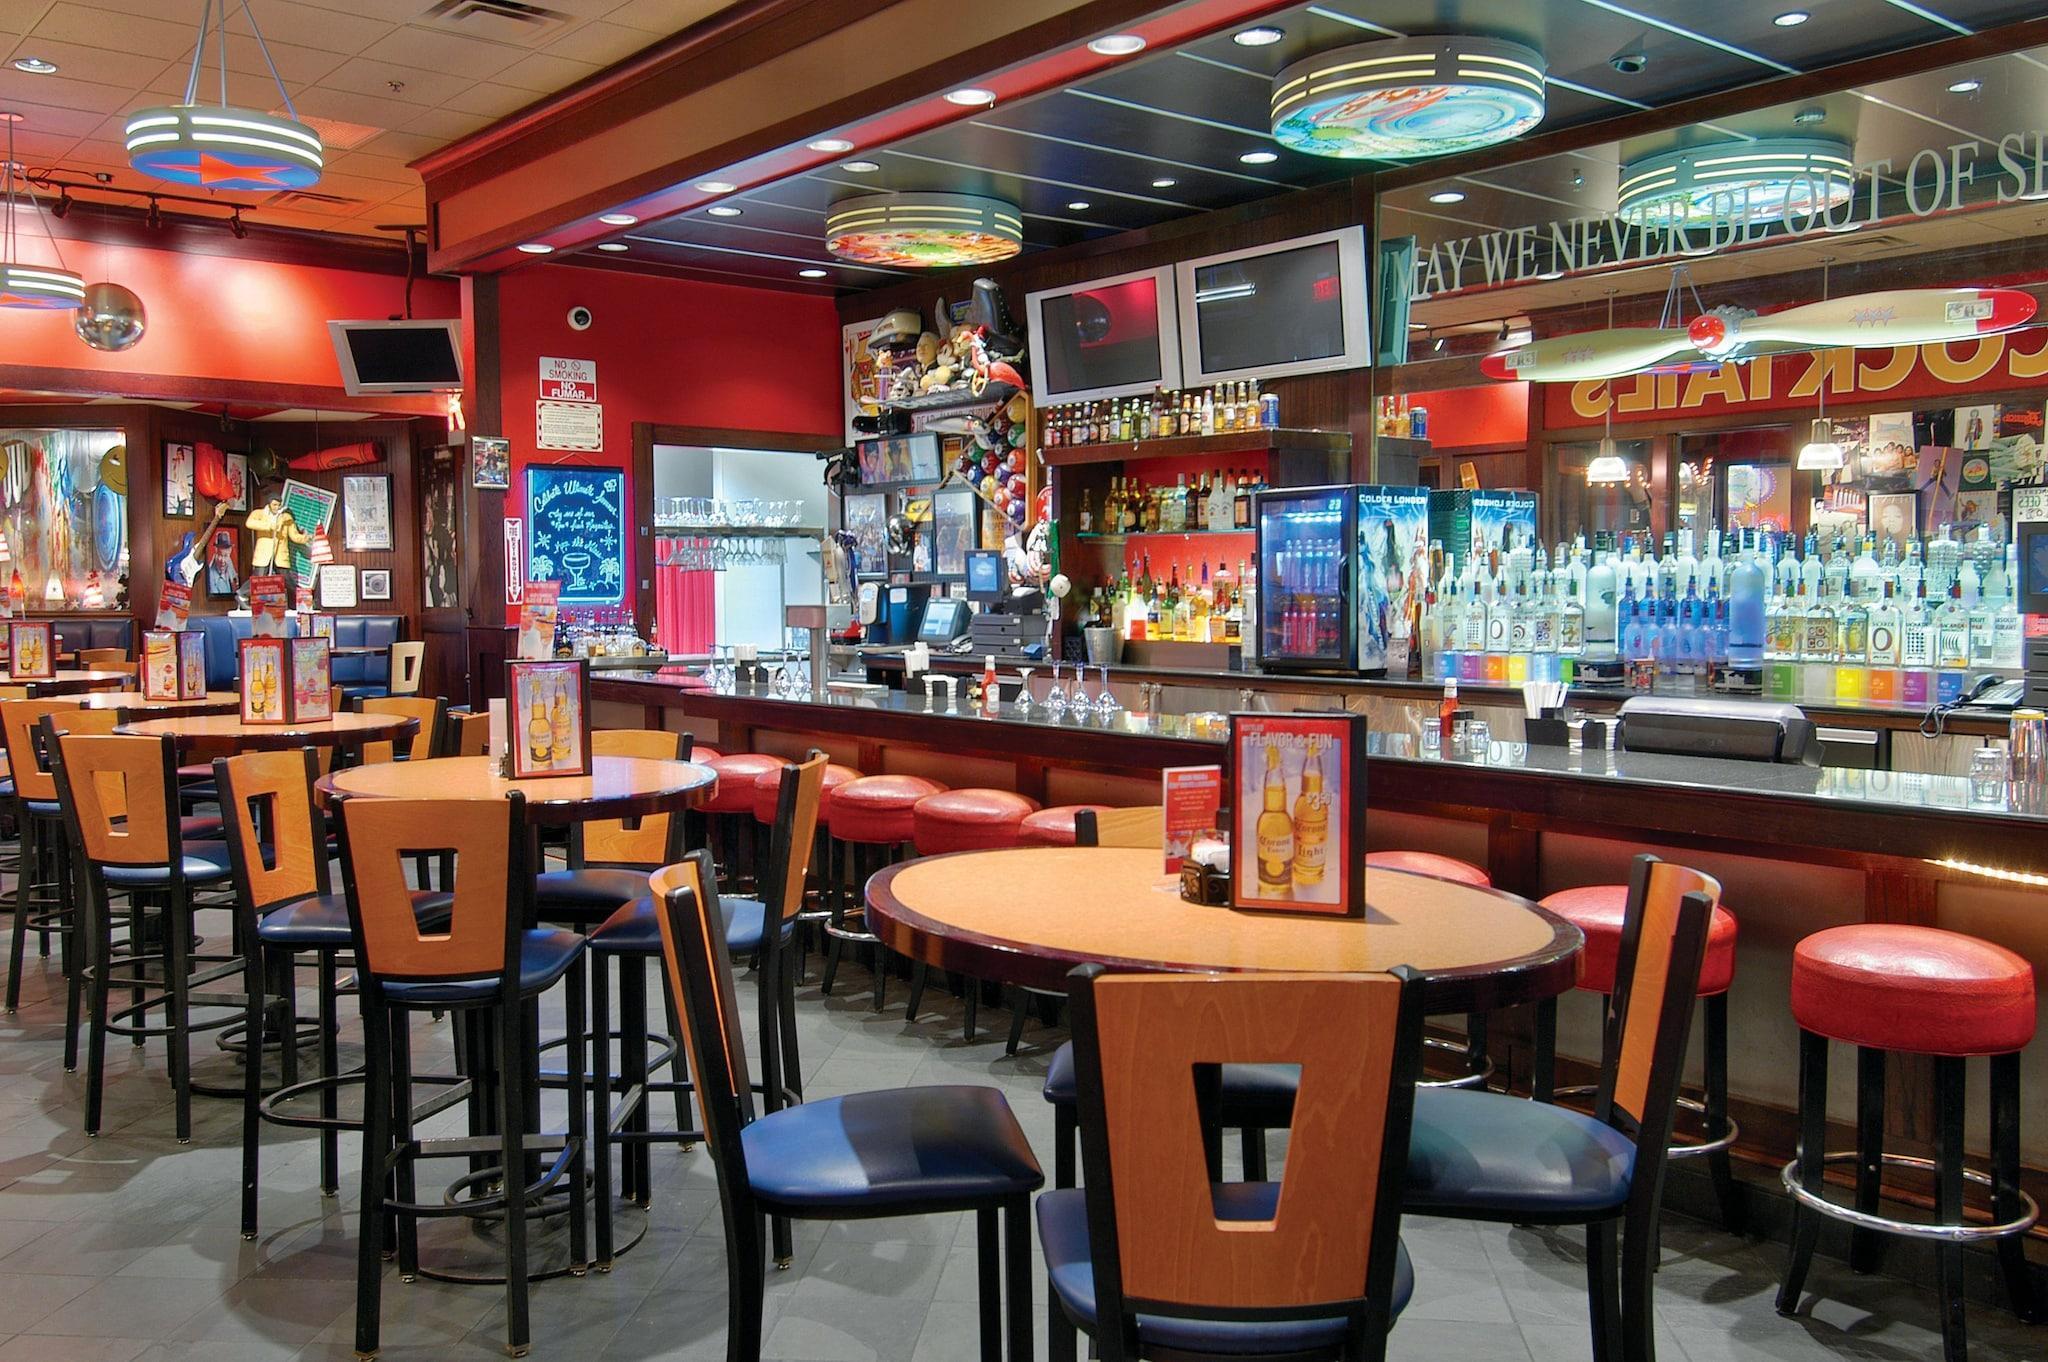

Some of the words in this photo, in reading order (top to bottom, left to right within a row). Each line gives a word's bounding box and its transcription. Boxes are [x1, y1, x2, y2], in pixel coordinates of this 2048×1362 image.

[1393, 237, 1473, 300] MAY
[1478, 225, 1540, 288] WE
[1549, 199, 1694, 275] NEVER
[1708, 187, 1769, 250] BE
[1783, 159, 1892, 237] OUT
[1905, 141, 1979, 217] OF
[554, 360, 567, 369] NO
[549, 369, 588, 381] SMOKING
[560, 381, 576, 391] NO
[551, 388, 585, 399] FUMAR
[1359, 494, 1392, 505] COLDER
[1250, 731, 1295, 748] FLAVOR
[1308, 733, 1333, 749] FUN
